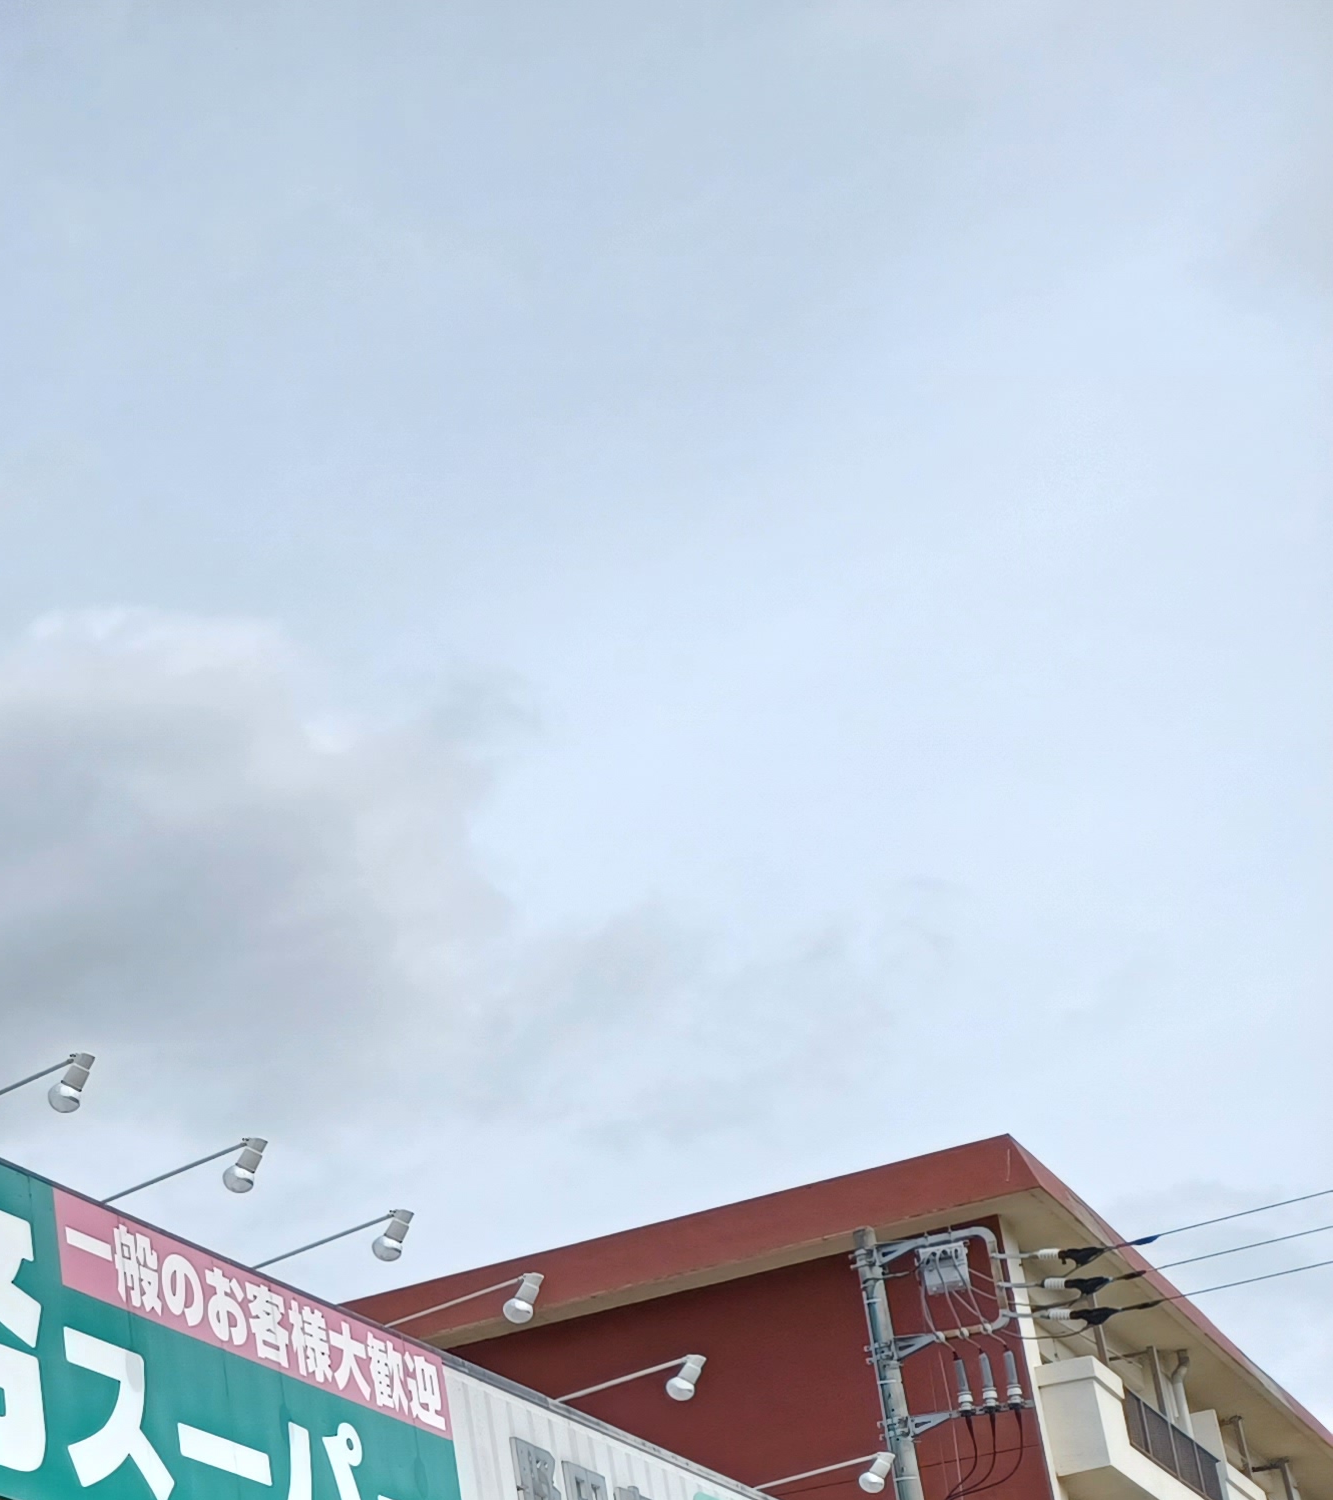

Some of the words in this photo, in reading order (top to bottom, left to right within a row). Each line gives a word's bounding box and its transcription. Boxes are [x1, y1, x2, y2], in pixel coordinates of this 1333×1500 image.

[63, 1222, 448, 1433] 一般のお客様大歓迎
